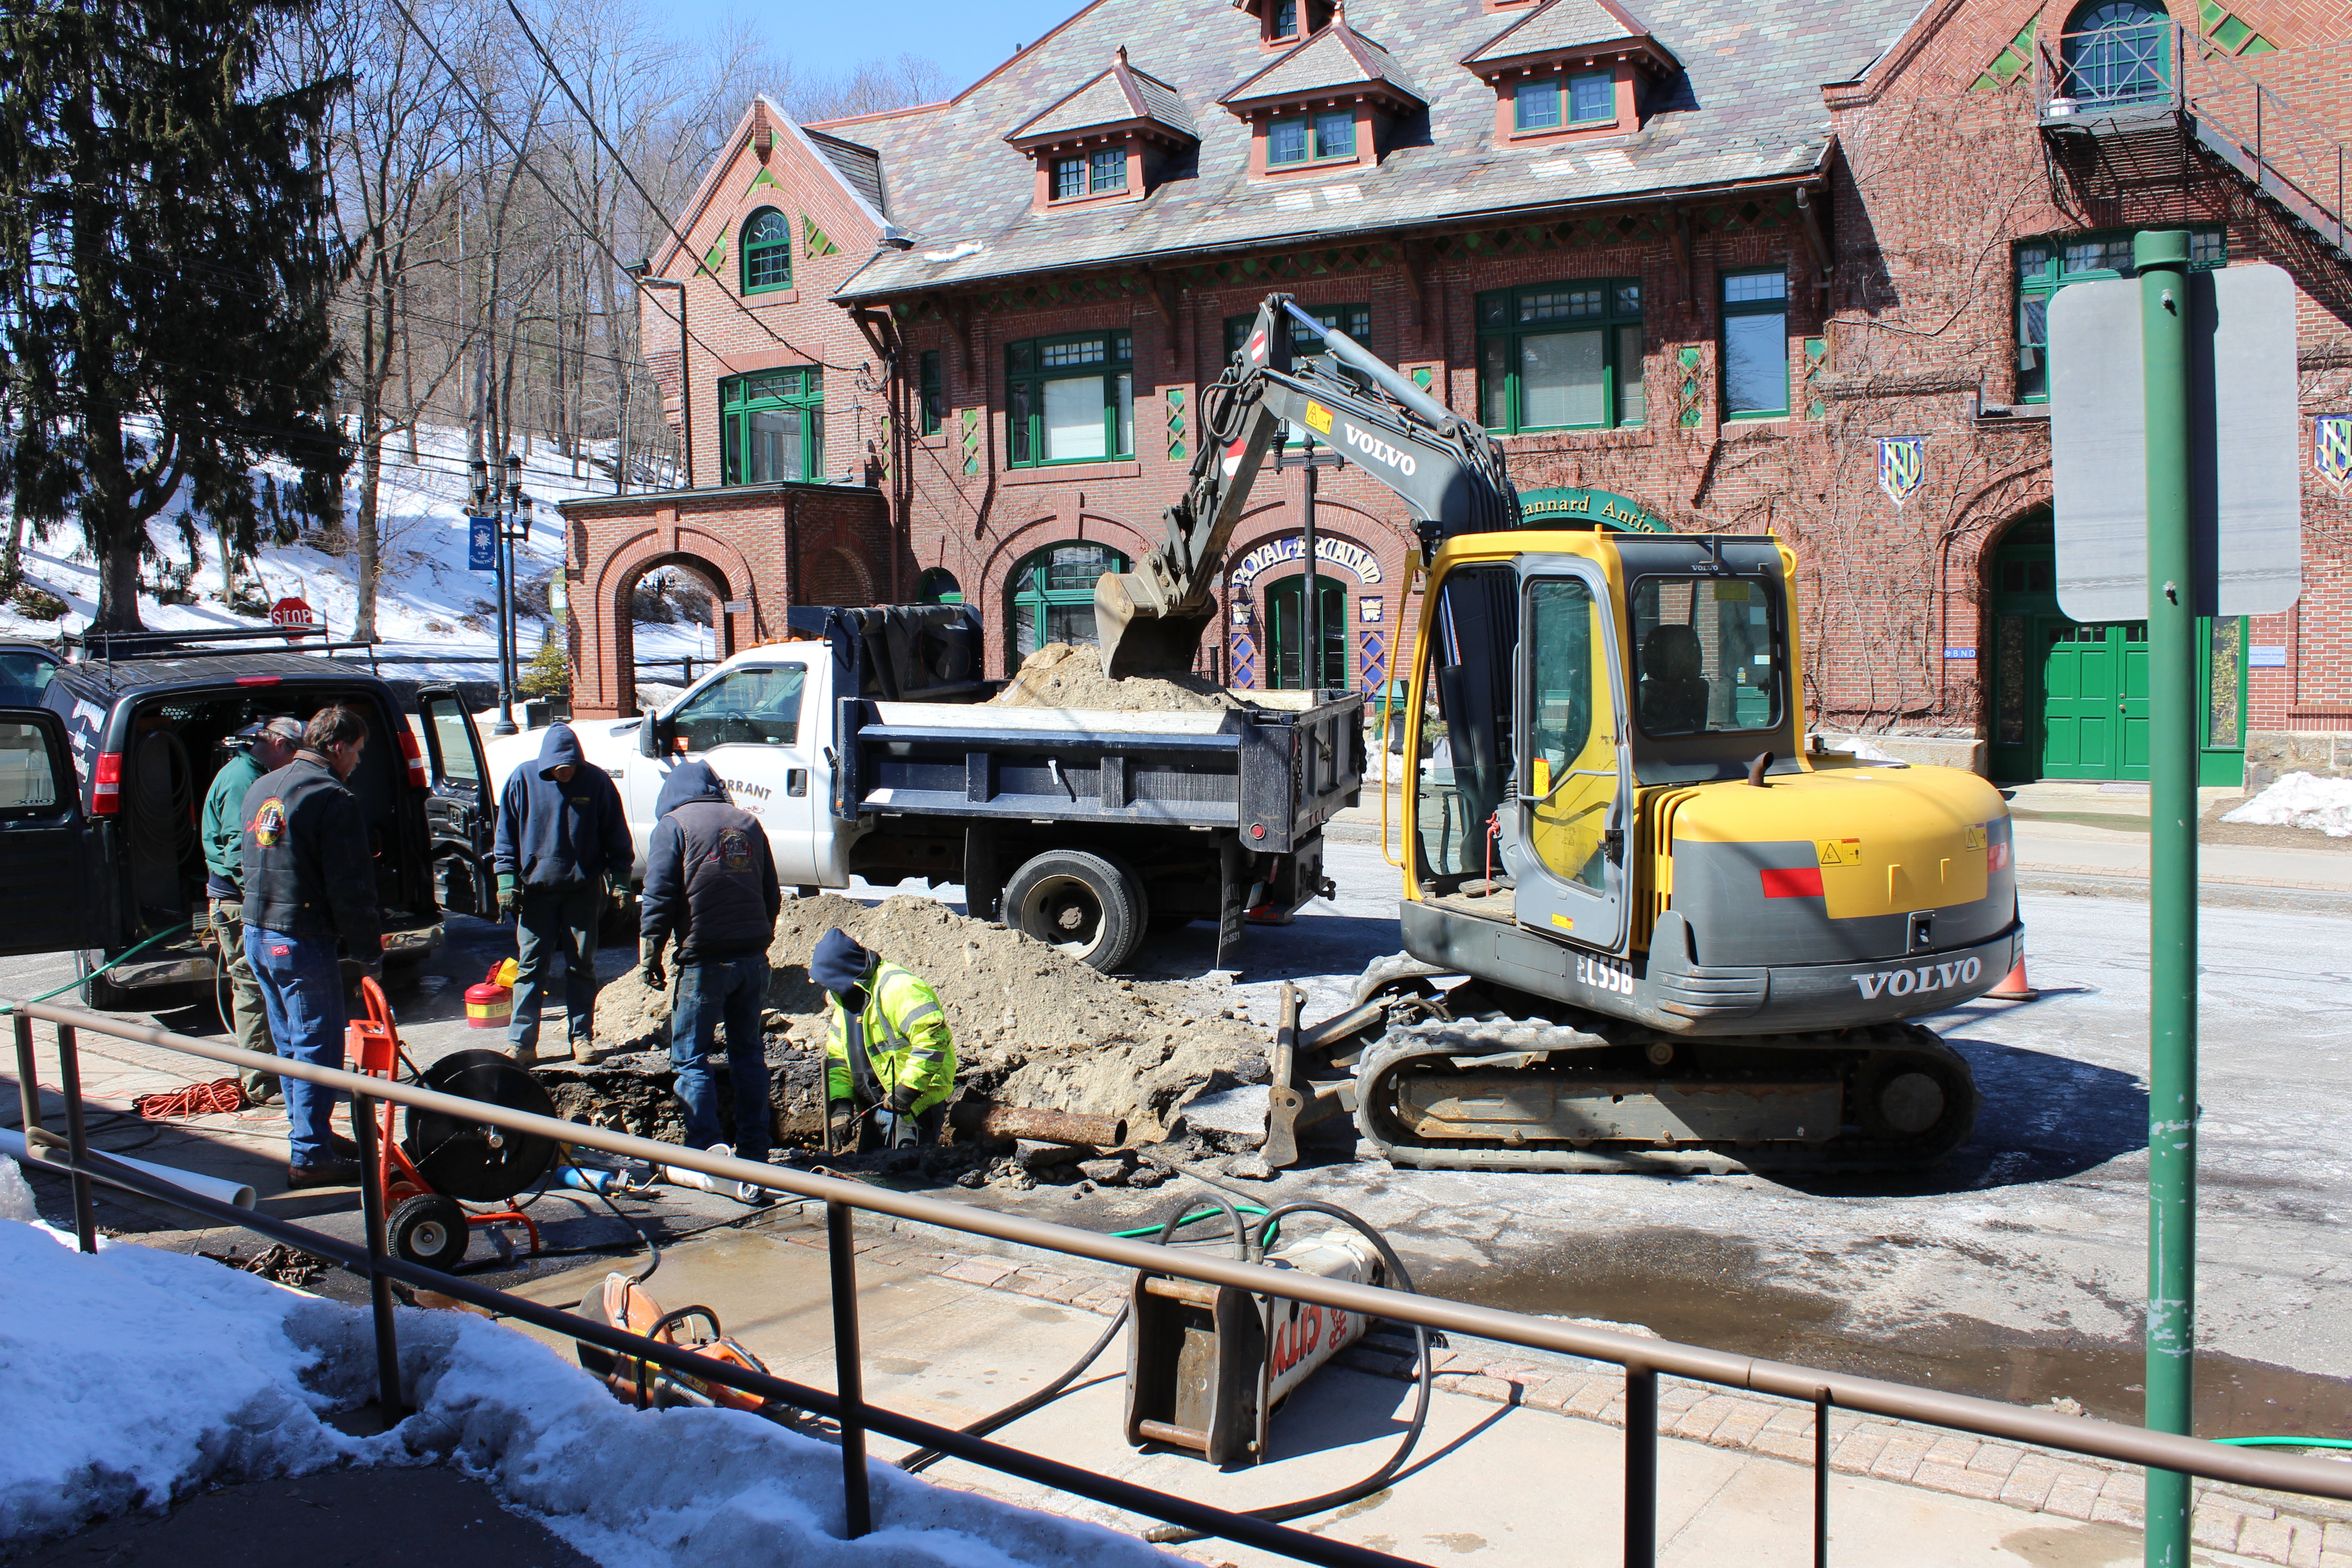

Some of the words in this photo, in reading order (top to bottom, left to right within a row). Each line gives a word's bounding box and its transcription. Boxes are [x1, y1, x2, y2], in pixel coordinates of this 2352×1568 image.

[1344, 423, 1416, 476] VOLVO
[1508, 495, 1590, 520] annard
[1601, 500, 1658, 533] Antiq
[1231, 539, 1292, 587] ROYAL
[273, 609, 311, 627] STOP
[1233, 612, 1250, 624] VMC
[1361, 609, 1382, 621] VMC
[1577, 951, 1633, 995] EC55B
[1851, 956, 1981, 1000] VOLVO
[1270, 1303, 1323, 1383] CITY
